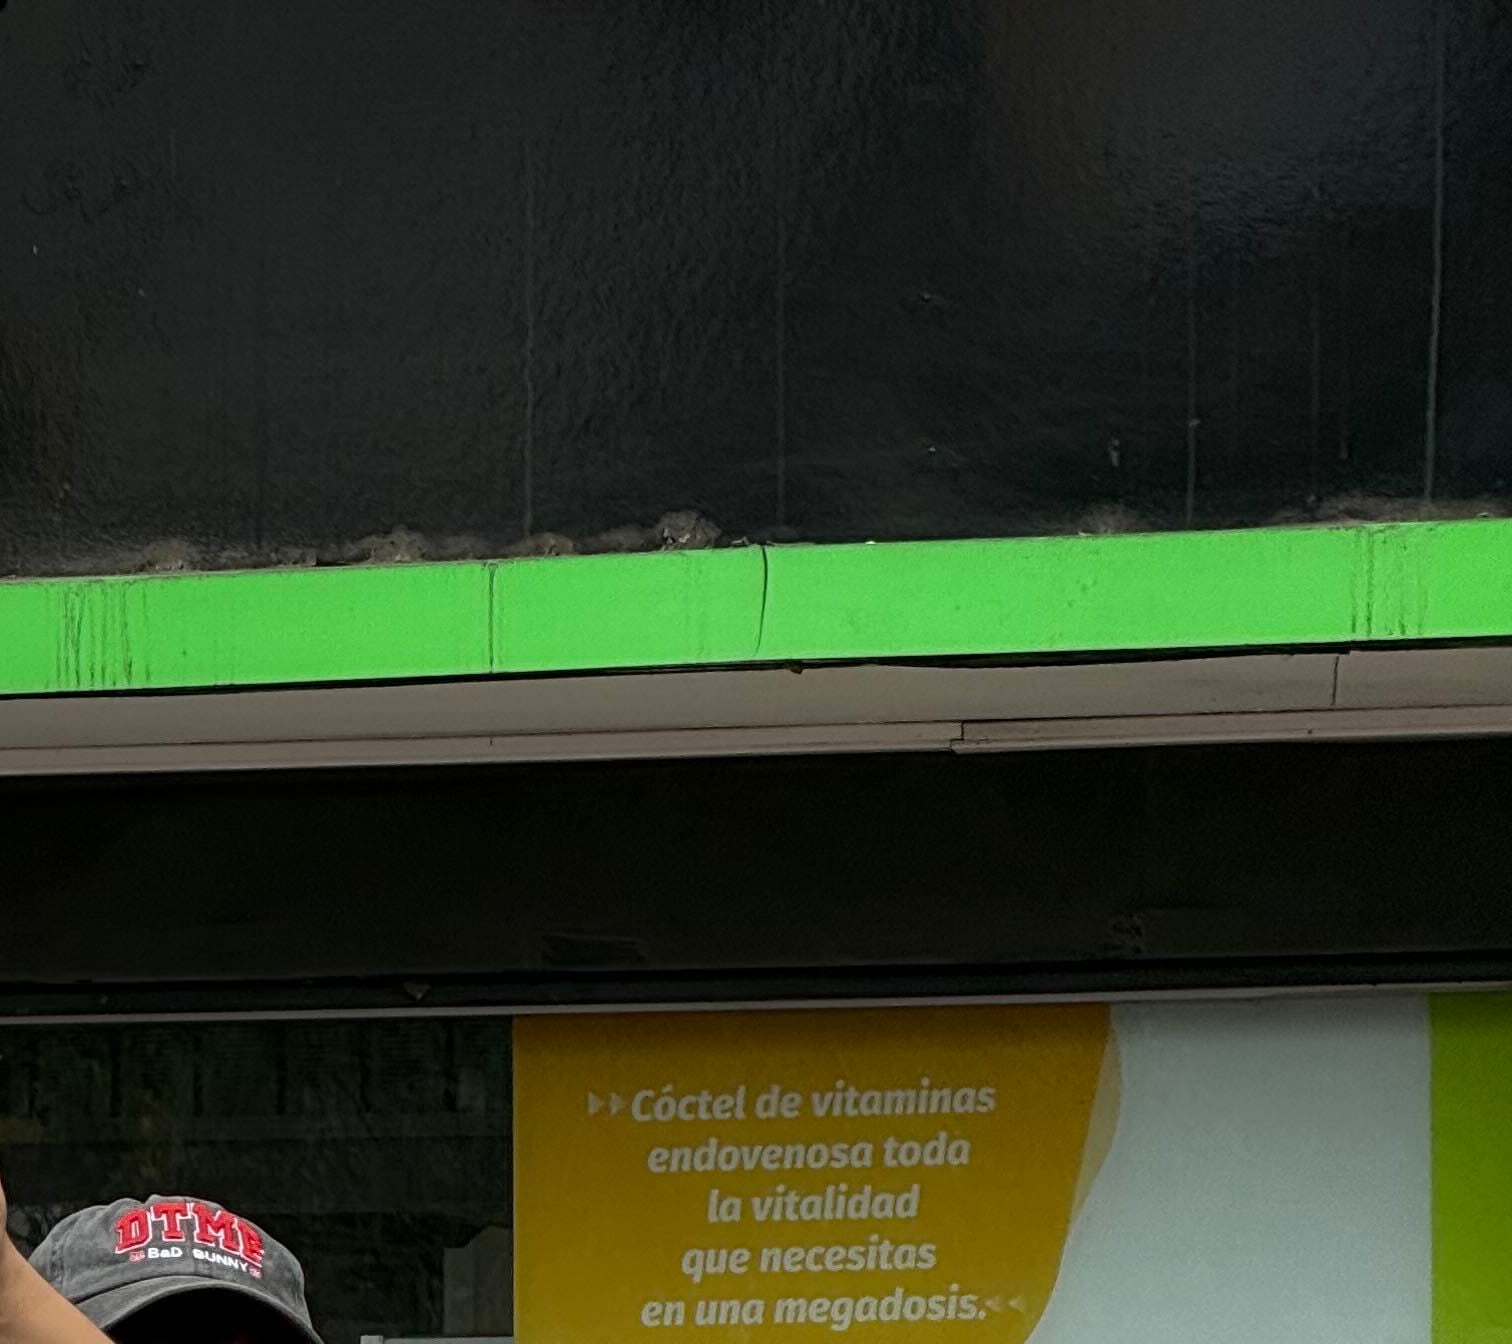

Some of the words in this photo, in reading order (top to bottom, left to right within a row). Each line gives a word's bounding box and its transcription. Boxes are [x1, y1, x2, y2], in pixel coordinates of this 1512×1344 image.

[631, 1084, 745, 1122] Cóctel
[756, 1085, 800, 1119] de
[811, 1078, 996, 1118] vitaminas
[648, 1138, 872, 1174] endovenosa
[883, 1132, 970, 1167] toda
[708, 1189, 742, 1222] la
[751, 1184, 920, 1221] vitalidad
[681, 1246, 749, 1282] que
[759, 1236, 937, 1273] necesitas
[641, 1297, 683, 1328] en
[695, 1295, 763, 1325] una
[774, 1285, 987, 1331] megadosis.
